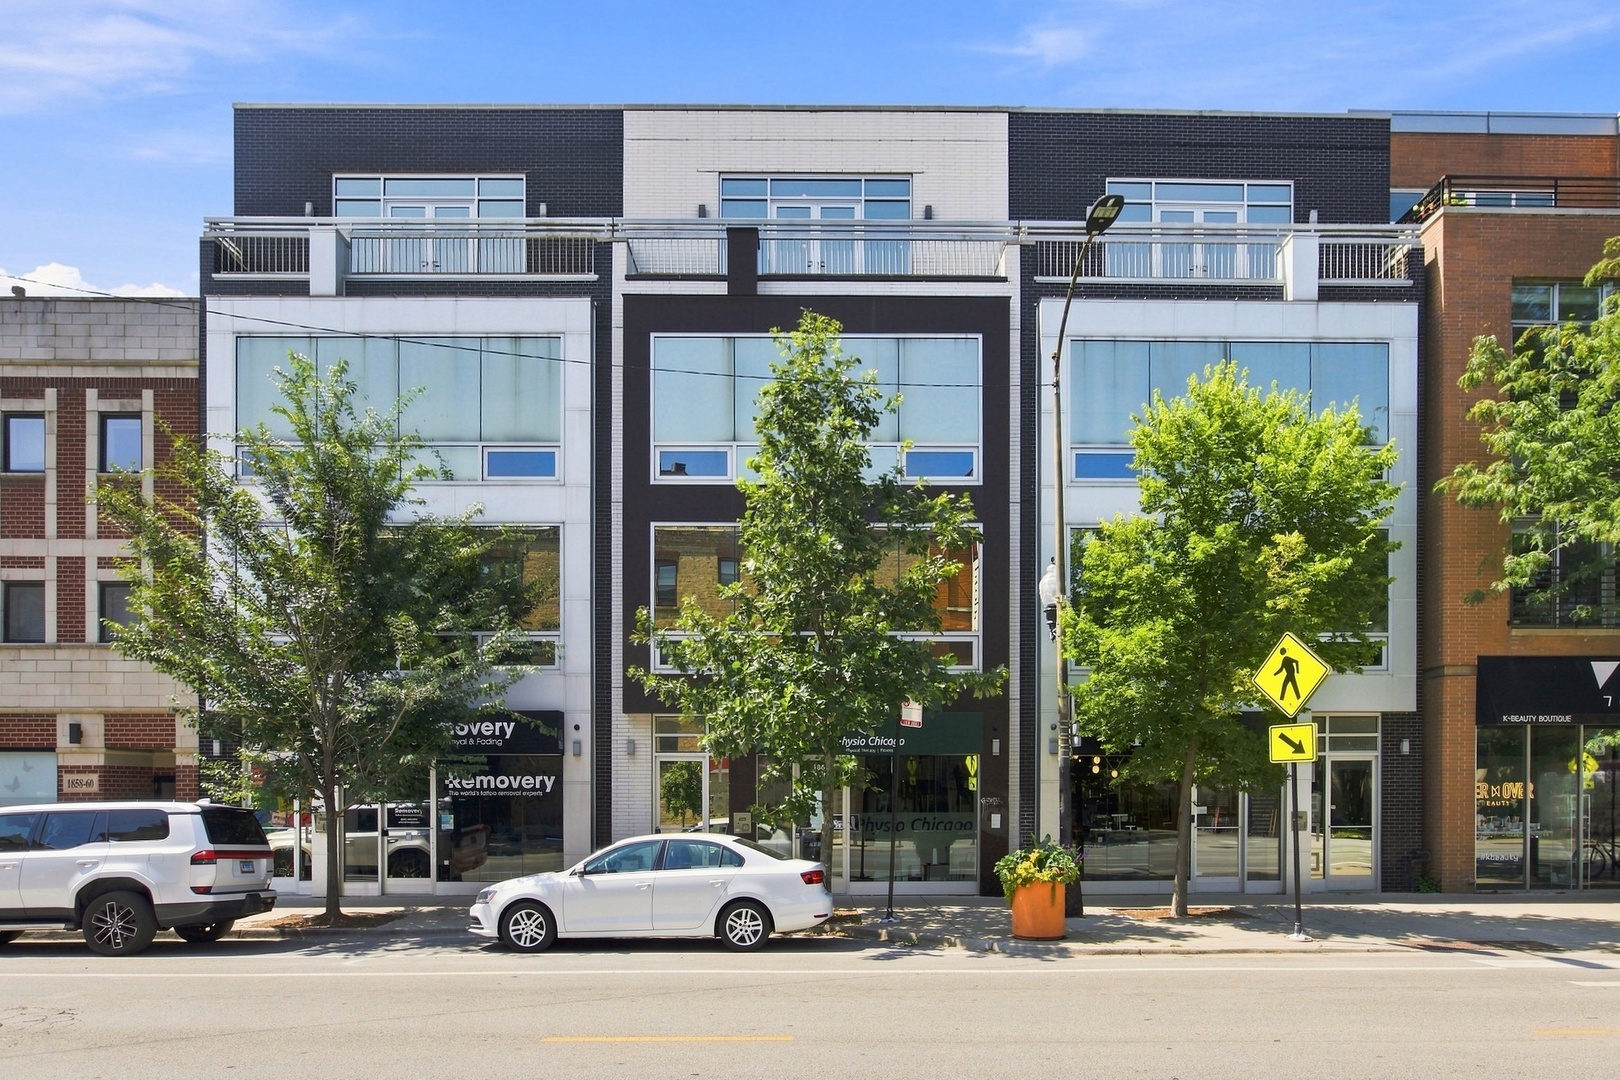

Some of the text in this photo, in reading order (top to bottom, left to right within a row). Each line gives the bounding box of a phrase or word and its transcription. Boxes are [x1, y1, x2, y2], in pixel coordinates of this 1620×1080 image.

[476, 738, 503, 746] Fading
[839, 736, 866, 748] hysio
[67, 778, 95, 789] 1858-60
